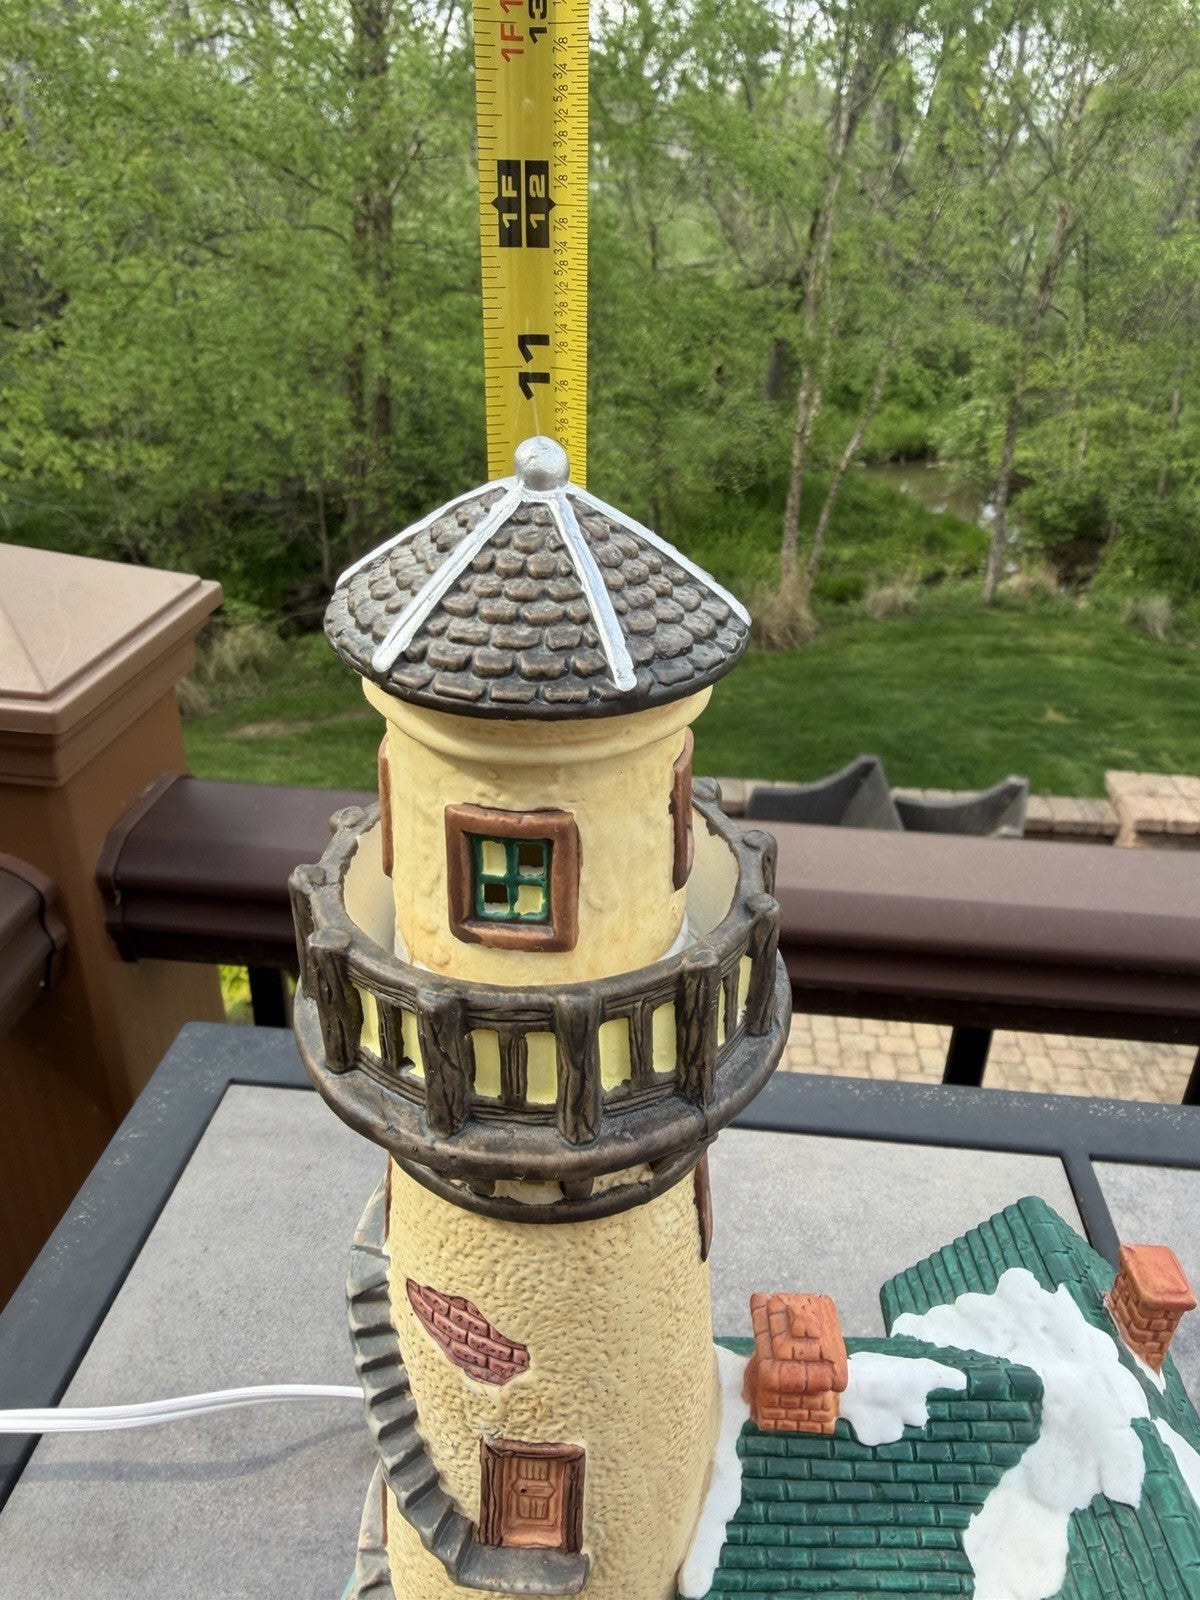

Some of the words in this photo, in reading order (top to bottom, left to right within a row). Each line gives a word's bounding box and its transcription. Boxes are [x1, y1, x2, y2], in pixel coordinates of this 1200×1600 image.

[528, 0, 548, 44] 13
[552, 36, 568, 53] 7/8
[552, 62, 568, 79] 3/4
[552, 84, 568, 102] 5/8
[553, 108, 569, 124] 1/2
[552, 130, 568, 147] 3/8
[553, 154, 568, 167] 1/4
[553, 174, 568, 189] 1/8
[501, 174, 518, 228] 1F
[529, 174, 546, 229] 12
[553, 217, 568, 232] 7/8
[553, 240, 568, 255] 3/4
[553, 259, 569, 276] 5/8
[554, 281, 569, 295] 1/2
[554, 301, 568, 316] 3/8
[554, 322, 568, 335] 1/4
[554, 341, 568, 354] 1/8
[517, 334, 550, 401] 11
[554, 379, 569, 393] 7/8
[554, 400, 568, 413] 3/4
[555, 418, 569, 432] 5/8
